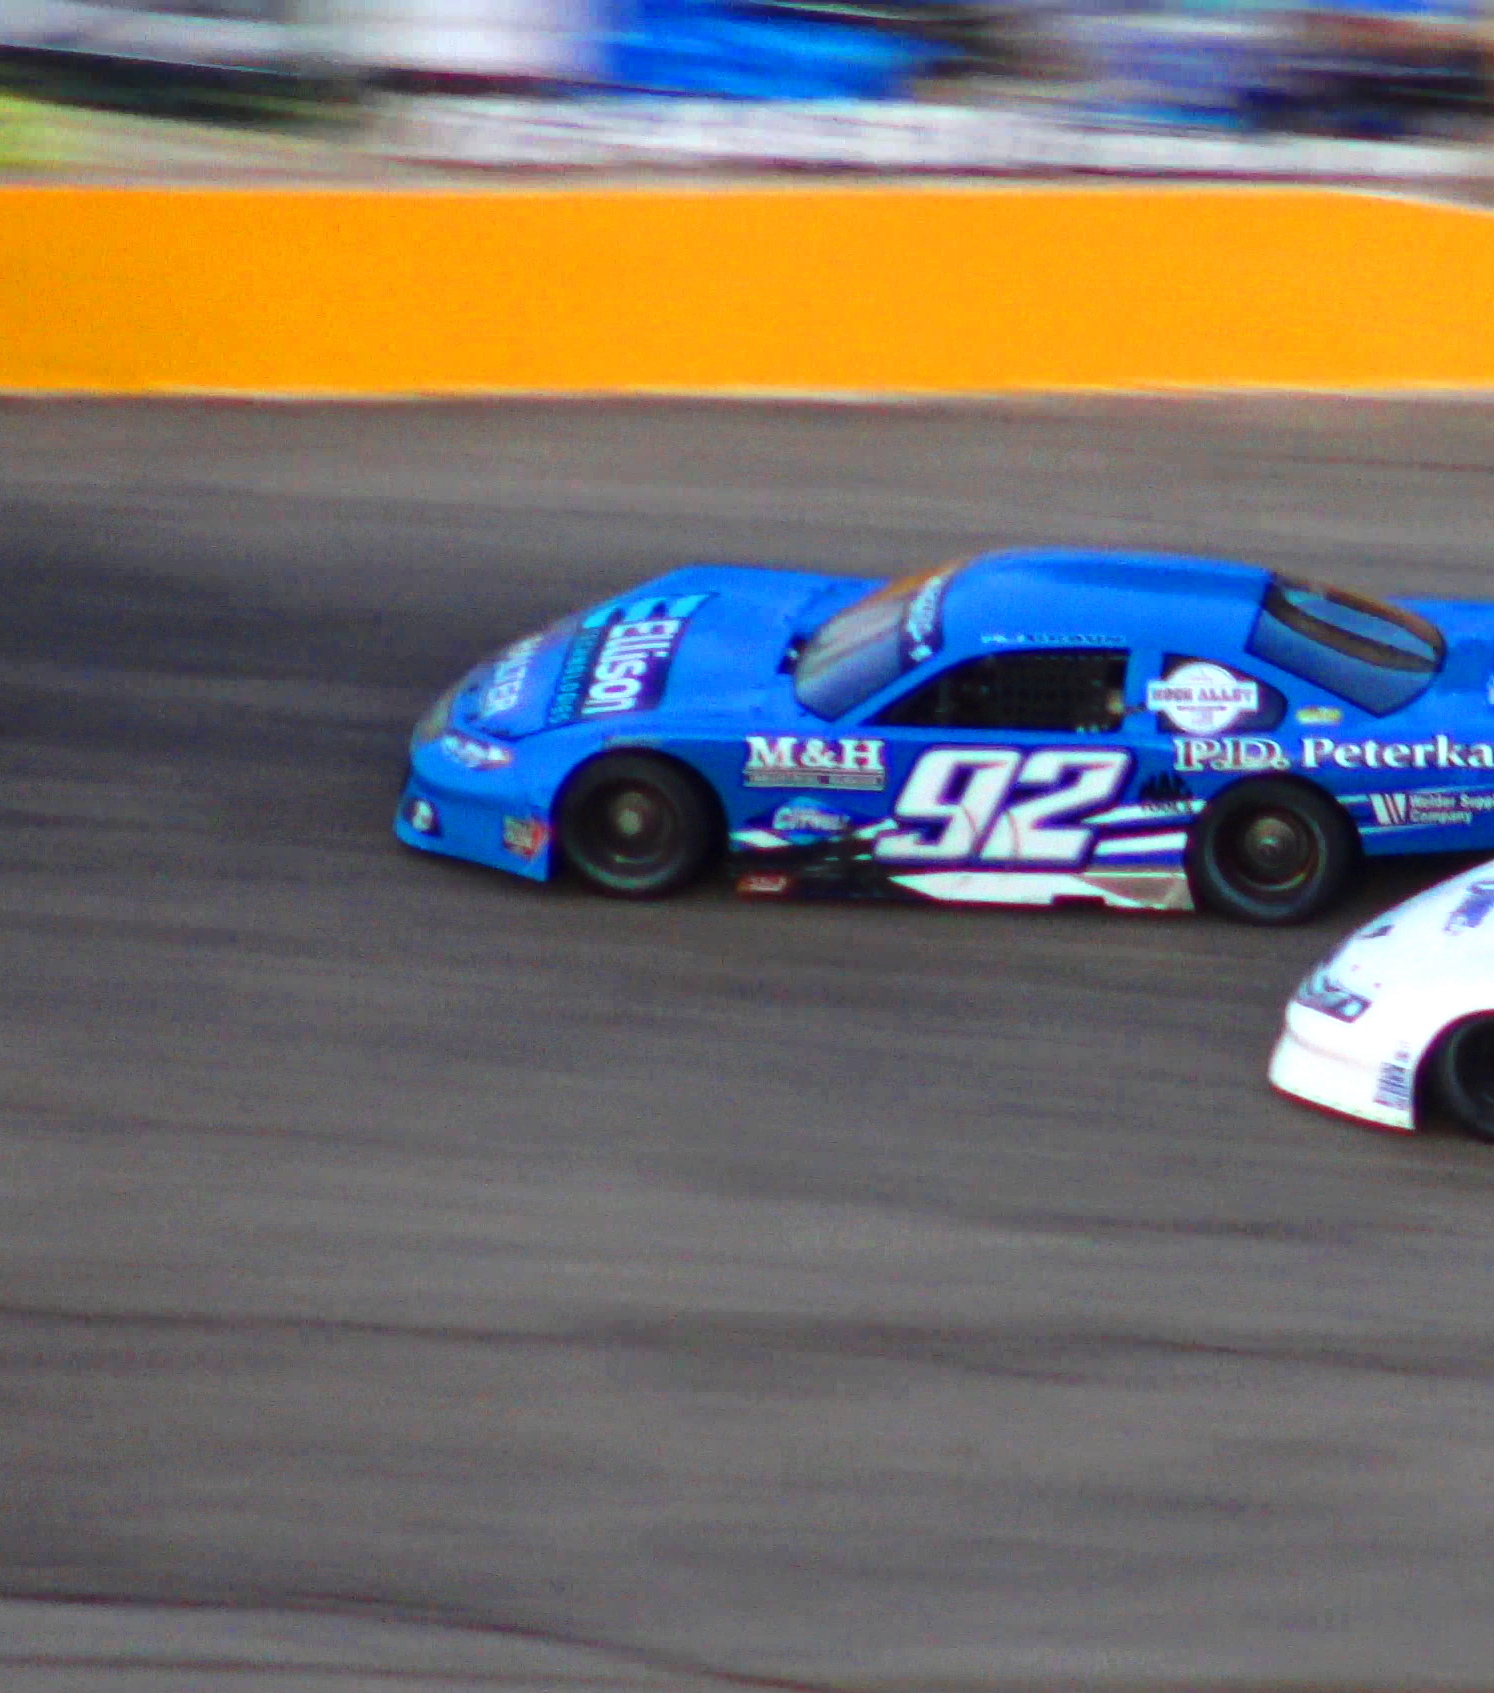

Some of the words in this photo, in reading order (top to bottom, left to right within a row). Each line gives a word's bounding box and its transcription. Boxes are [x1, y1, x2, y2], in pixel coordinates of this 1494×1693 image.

[582, 619, 682, 715] Ellison
[743, 736, 886, 769] M&H
[1173, 736, 1292, 771] P.D.
[873, 748, 1132, 861] 92
[1410, 810, 1473, 825] Company
